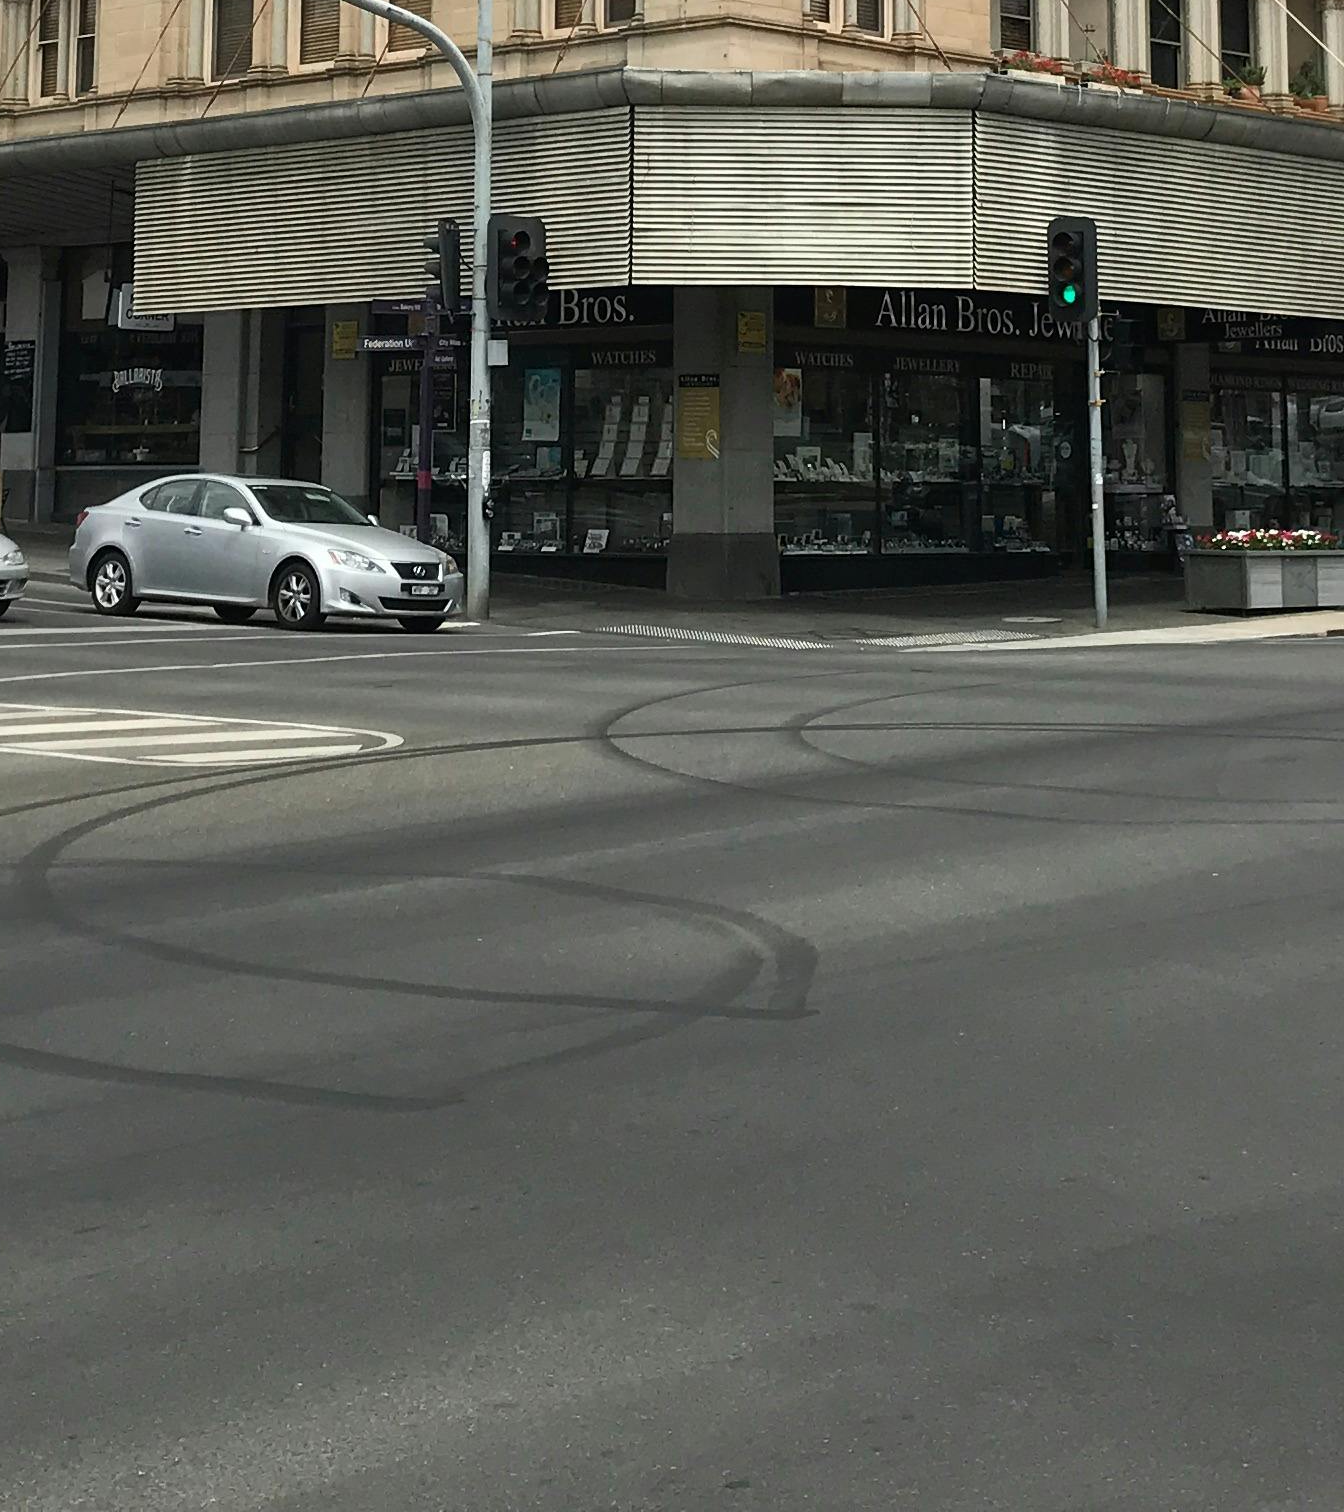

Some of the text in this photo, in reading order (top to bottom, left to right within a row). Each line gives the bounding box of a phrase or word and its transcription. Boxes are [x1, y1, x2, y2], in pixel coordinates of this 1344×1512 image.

[557, 289, 635, 325] Bros.
[875, 290, 947, 331] Allan
[956, 295, 1020, 336] Bros.
[1224, 322, 1283, 339] Jewellers
[364, 338, 404, 349] Federation
[591, 350, 657, 365] WATCHES
[795, 351, 855, 368] WATCHES
[894, 356, 961, 374] JEWELLERY
